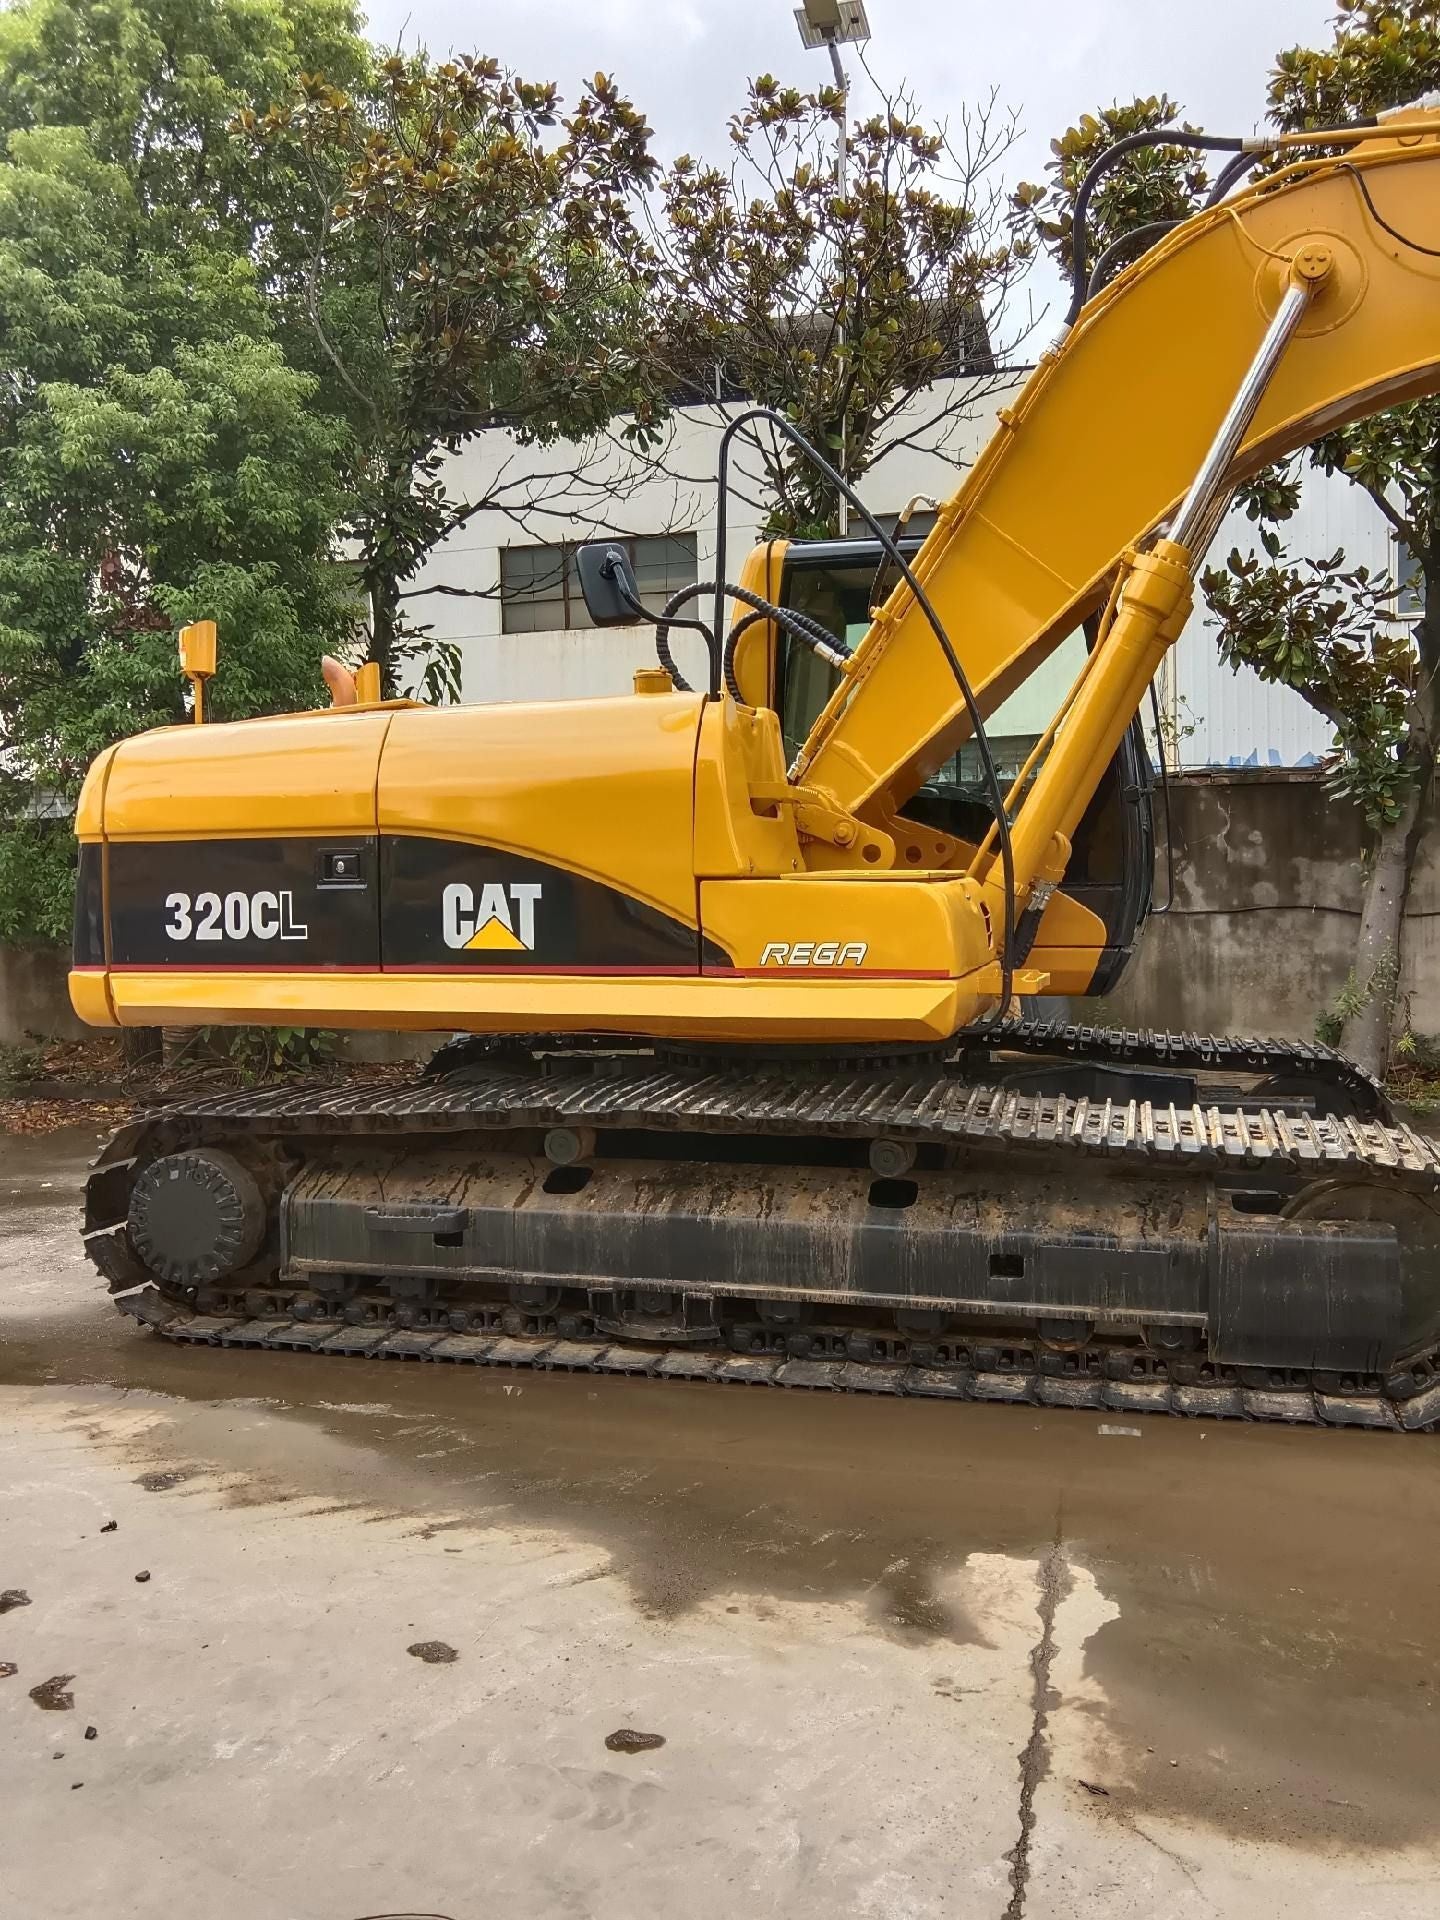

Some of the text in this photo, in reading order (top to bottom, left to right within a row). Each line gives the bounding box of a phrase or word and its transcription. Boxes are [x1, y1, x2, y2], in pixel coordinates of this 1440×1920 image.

[165, 891, 308, 941] 320CL
[443, 883, 542, 950] CAT
[760, 942, 868, 966] REGA
